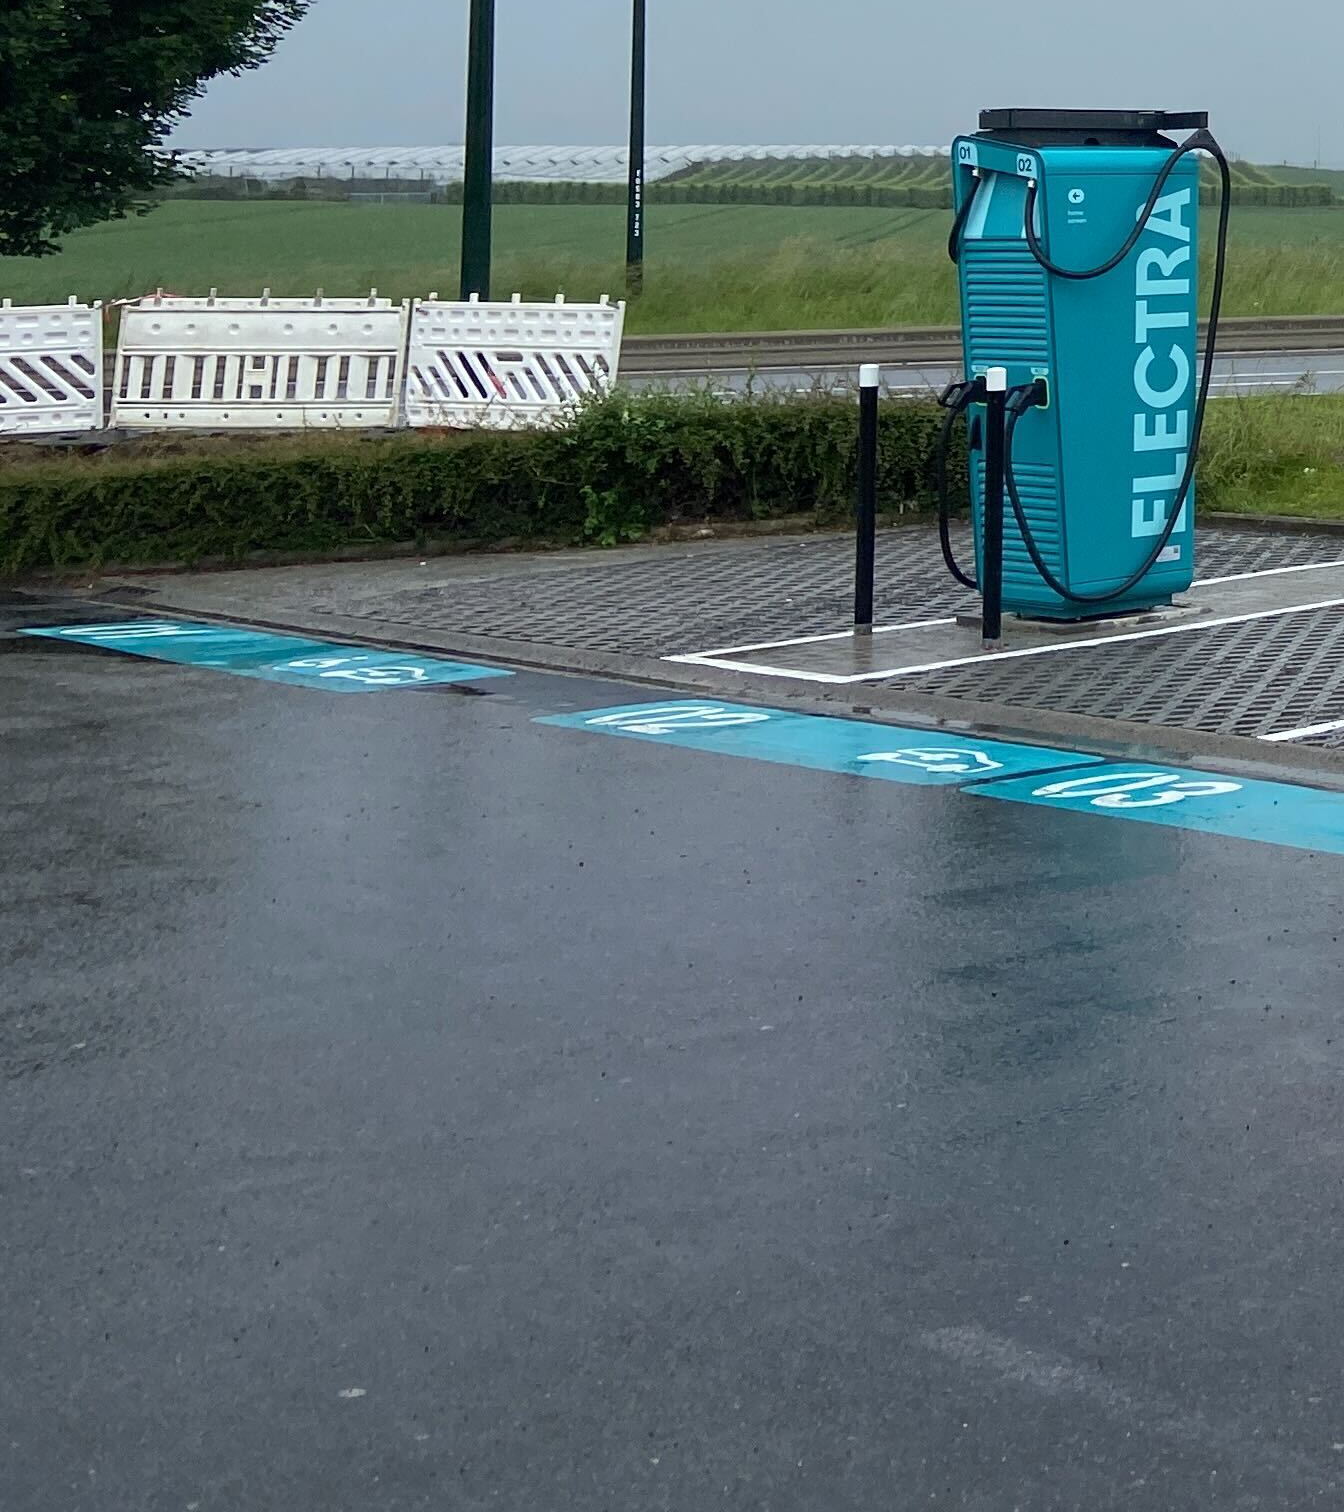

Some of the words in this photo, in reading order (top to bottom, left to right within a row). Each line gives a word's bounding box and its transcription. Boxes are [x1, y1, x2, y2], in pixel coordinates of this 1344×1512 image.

[959, 146, 971, 160] 01
[1018, 158, 1033, 172] 02
[1131, 187, 1191, 538] ELECTRA
[585, 706, 771, 735] 02
[1032, 772, 1244, 808] 03
